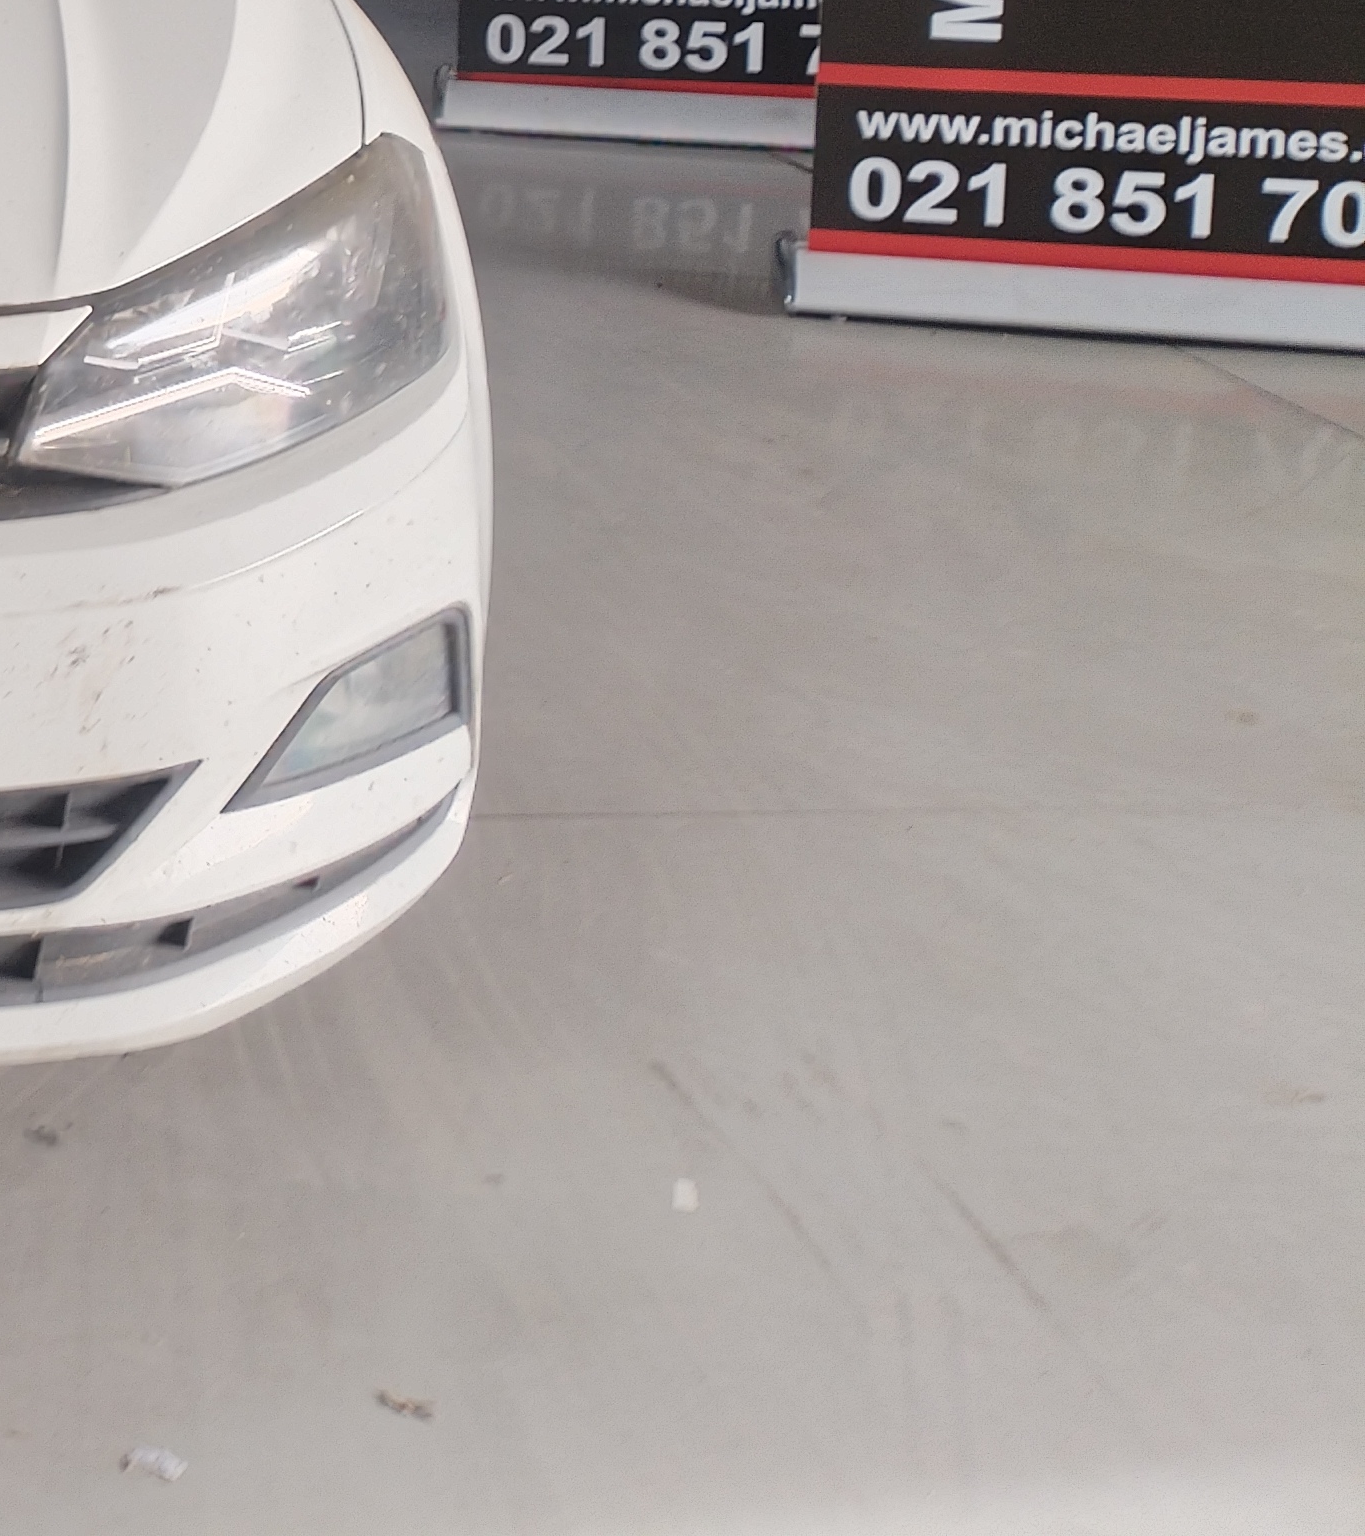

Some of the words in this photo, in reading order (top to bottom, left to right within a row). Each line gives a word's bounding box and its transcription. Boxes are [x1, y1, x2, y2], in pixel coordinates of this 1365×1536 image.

[486, 14, 605, 66] 021
[639, 19, 764, 73] 851
[853, 110, 1362, 172] www.michaeljames.
[849, 157, 1006, 226] 021
[1050, 168, 1214, 238] 851
